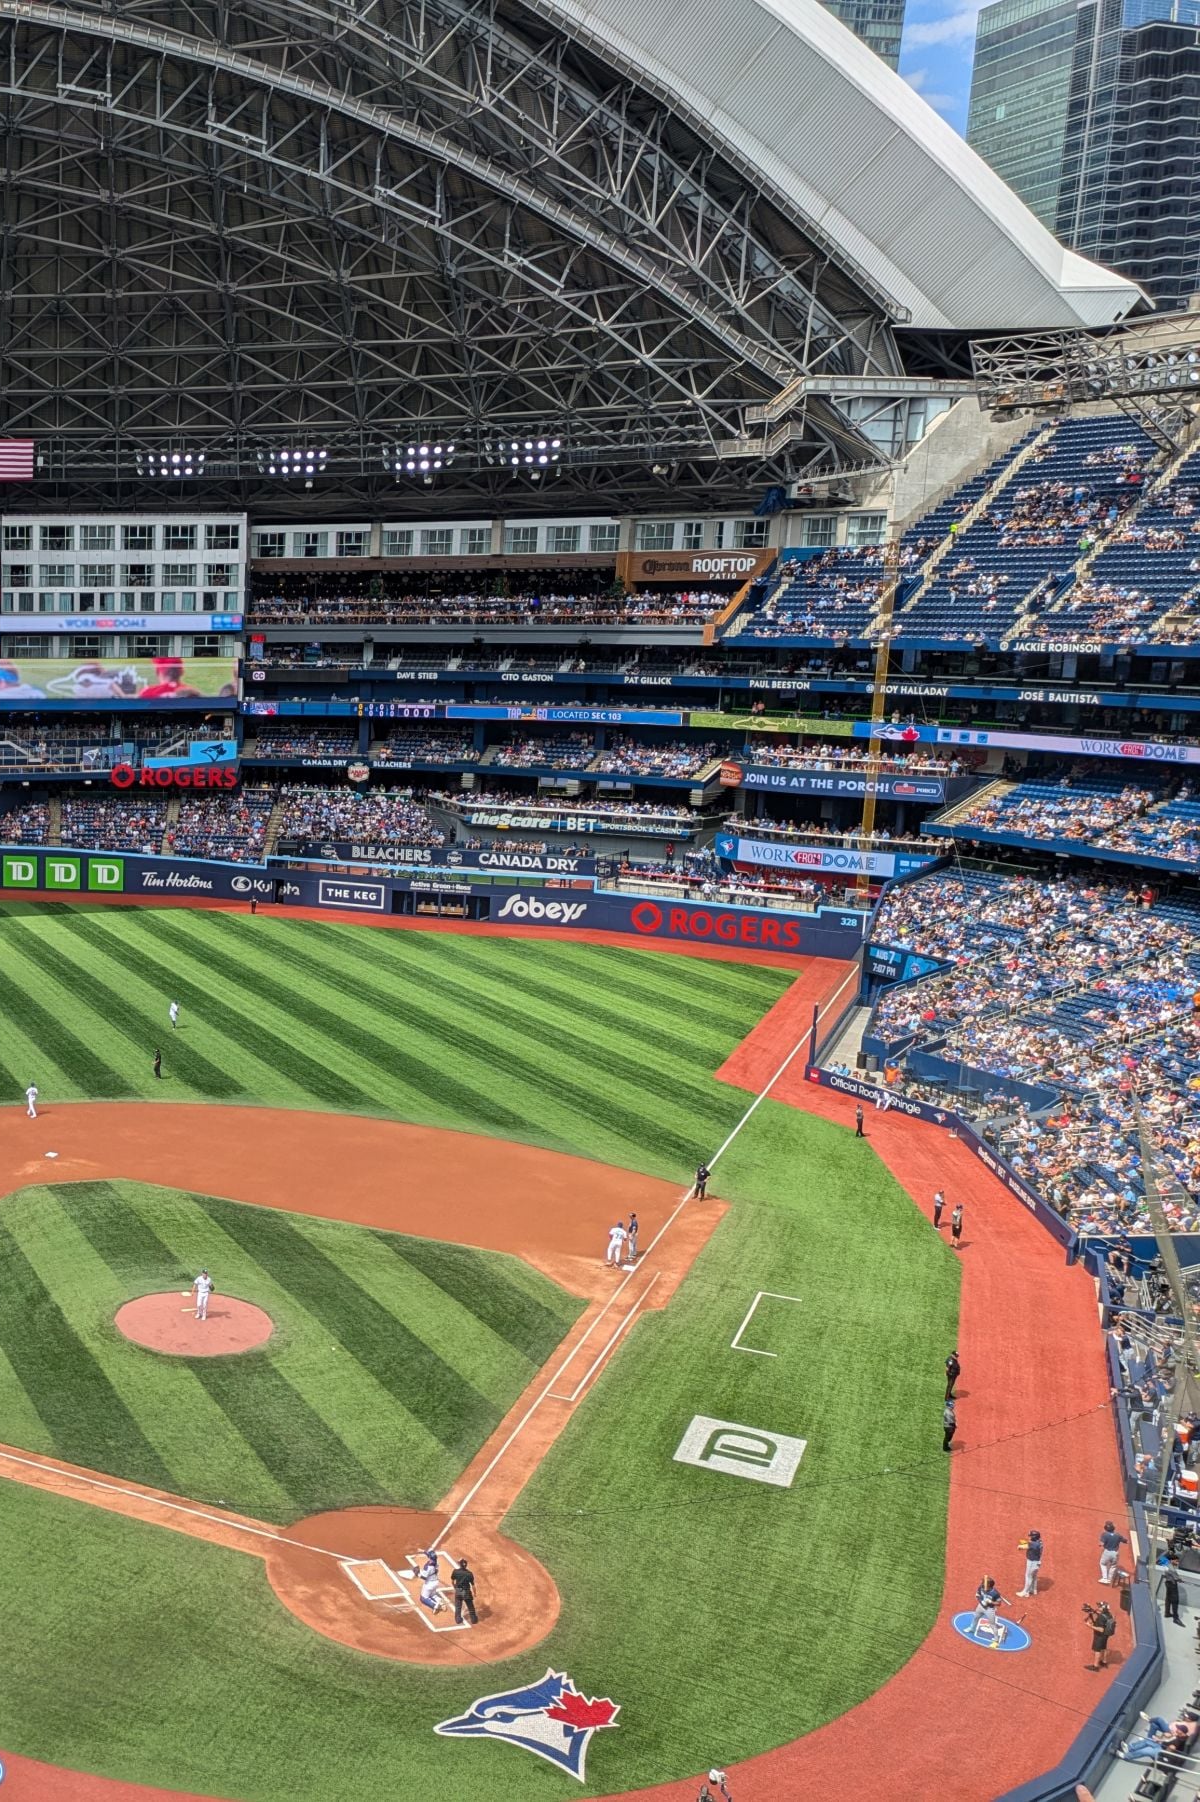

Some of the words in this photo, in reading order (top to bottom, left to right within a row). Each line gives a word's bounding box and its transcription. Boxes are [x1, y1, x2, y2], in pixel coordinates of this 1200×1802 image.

[692, 558, 756, 573] ROOFTOP
[1013, 642, 1046, 652] JACKIE
[1048, 643, 1100, 653] ROBINSON
[502, 673, 519, 681] CITO
[624, 676, 639, 684] PAT
[640, 677, 672, 685] GILLICK
[750, 680, 770, 688] PAUL
[772, 681, 810, 689] BEESTON
[880, 685, 898, 694] ROY
[901, 686, 948, 696] HALLADAY
[1018, 690, 1044, 700] JOSÉ
[1049, 693, 1099, 704] BAUTISTA
[507, 708, 521, 719] TAP
[536, 708, 547, 719] GO
[553, 711, 589, 719] LOCATED
[591, 712, 606, 720] SEC
[608, 712, 621, 720] 103
[1081, 740, 1120, 754] WORK
[1144, 744, 1186, 760] DOME
[373, 760, 412, 768] BLEACHERS
[139, 767, 238, 788] ROGERS
[744, 773, 768, 786] JOIN
[772, 775, 786, 786] US
[790, 777, 806, 787] AT
[810, 778, 833, 789] THE
[838, 780, 889, 793] PORCH!
[471, 812, 551, 828] theScore
[567, 817, 596, 832] BET
[601, 823, 647, 833] SPORTSBOOK
[352, 846, 431, 861] BLEACHERS
[479, 853, 543, 869] CANADA
[751, 845, 794, 862] WORK
[797, 851, 822, 865] FROM
[822, 854, 875, 871] DOME
[7, 862, 34, 881] TD
[50, 863, 76, 883] TD
[92, 864, 120, 884] TD
[141, 871, 167, 887] Tim
[166, 872, 213, 889] Hortons
[327, 888, 349, 898] THE
[354, 891, 377, 901] KEG
[498, 893, 587, 923] Sobeys
[669, 908, 801, 948] ROGERS
[840, 917, 857, 927] 328
[876, 949, 888, 961] AUG
[889, 950, 896, 965] 7
[872, 963, 885, 974] 7:07
[886, 965, 896, 977] PM
[830, 1076, 857, 1092] Official
[891, 1096, 921, 1114] Shingle
[700, 1428, 778, 1468] TD
